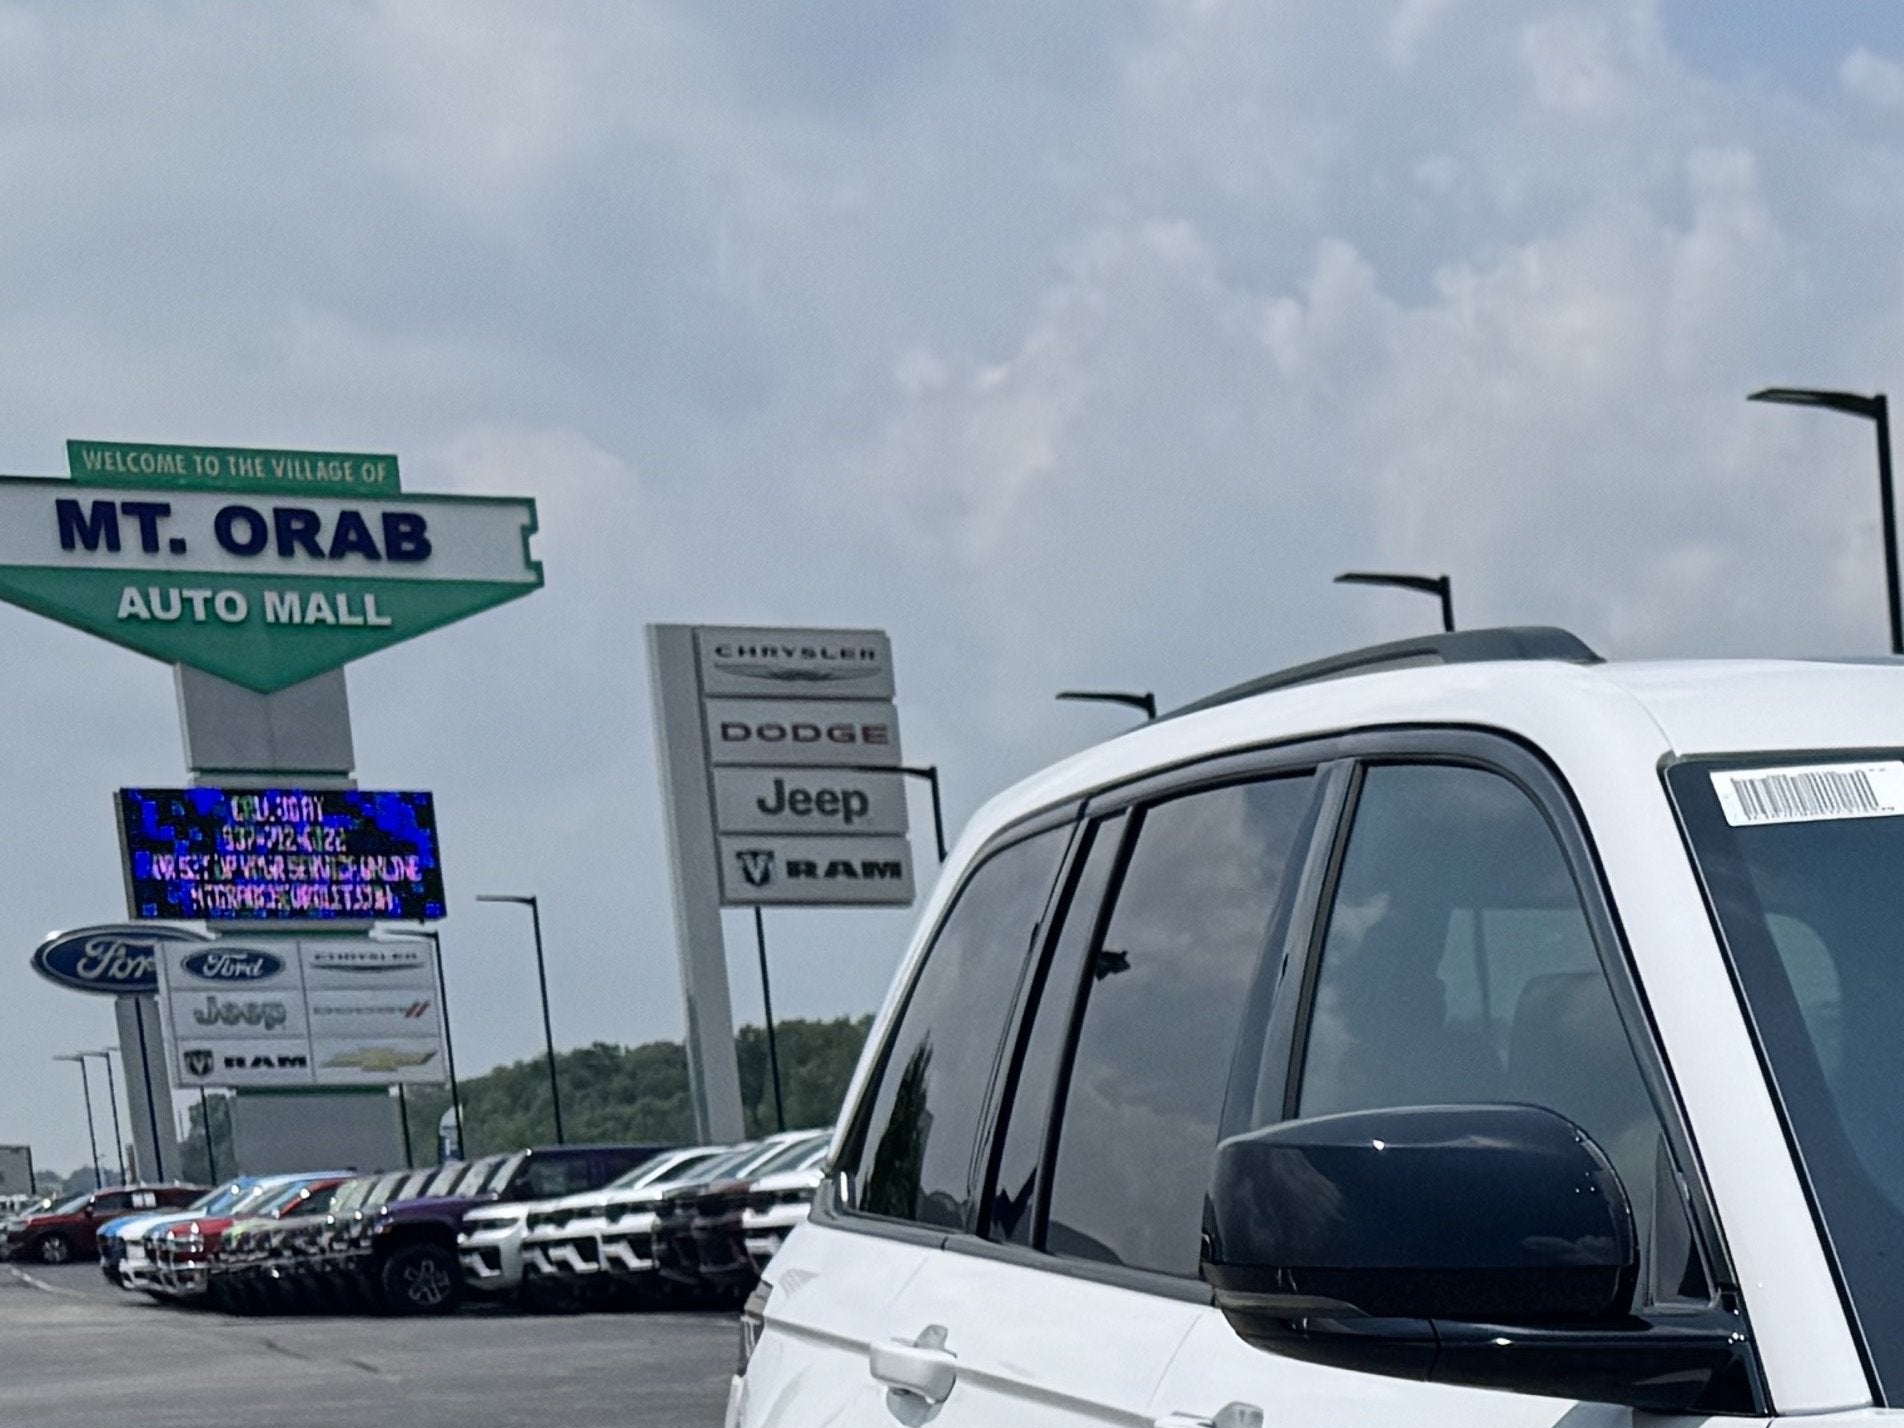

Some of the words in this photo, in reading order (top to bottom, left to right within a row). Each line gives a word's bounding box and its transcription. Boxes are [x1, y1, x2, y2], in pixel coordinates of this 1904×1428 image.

[82, 449, 190, 476] WELCOME
[194, 455, 219, 477] TO
[227, 456, 265, 479] THE
[272, 459, 354, 482] VILLAGE
[362, 462, 387, 484] OF
[55, 498, 187, 555] MT.
[214, 505, 432, 563] ORAB
[117, 586, 247, 623] AUTO
[264, 590, 392, 627] MALL
[714, 645, 876, 661] CHRYSLER
[720, 722, 890, 745] DODGE
[757, 777, 869, 824] Jeep
[786, 860, 902, 880] RAM
[202, 951, 264, 980] Ford
[194, 996, 286, 1030] Jeep
[224, 1055, 307, 1069] RAM
